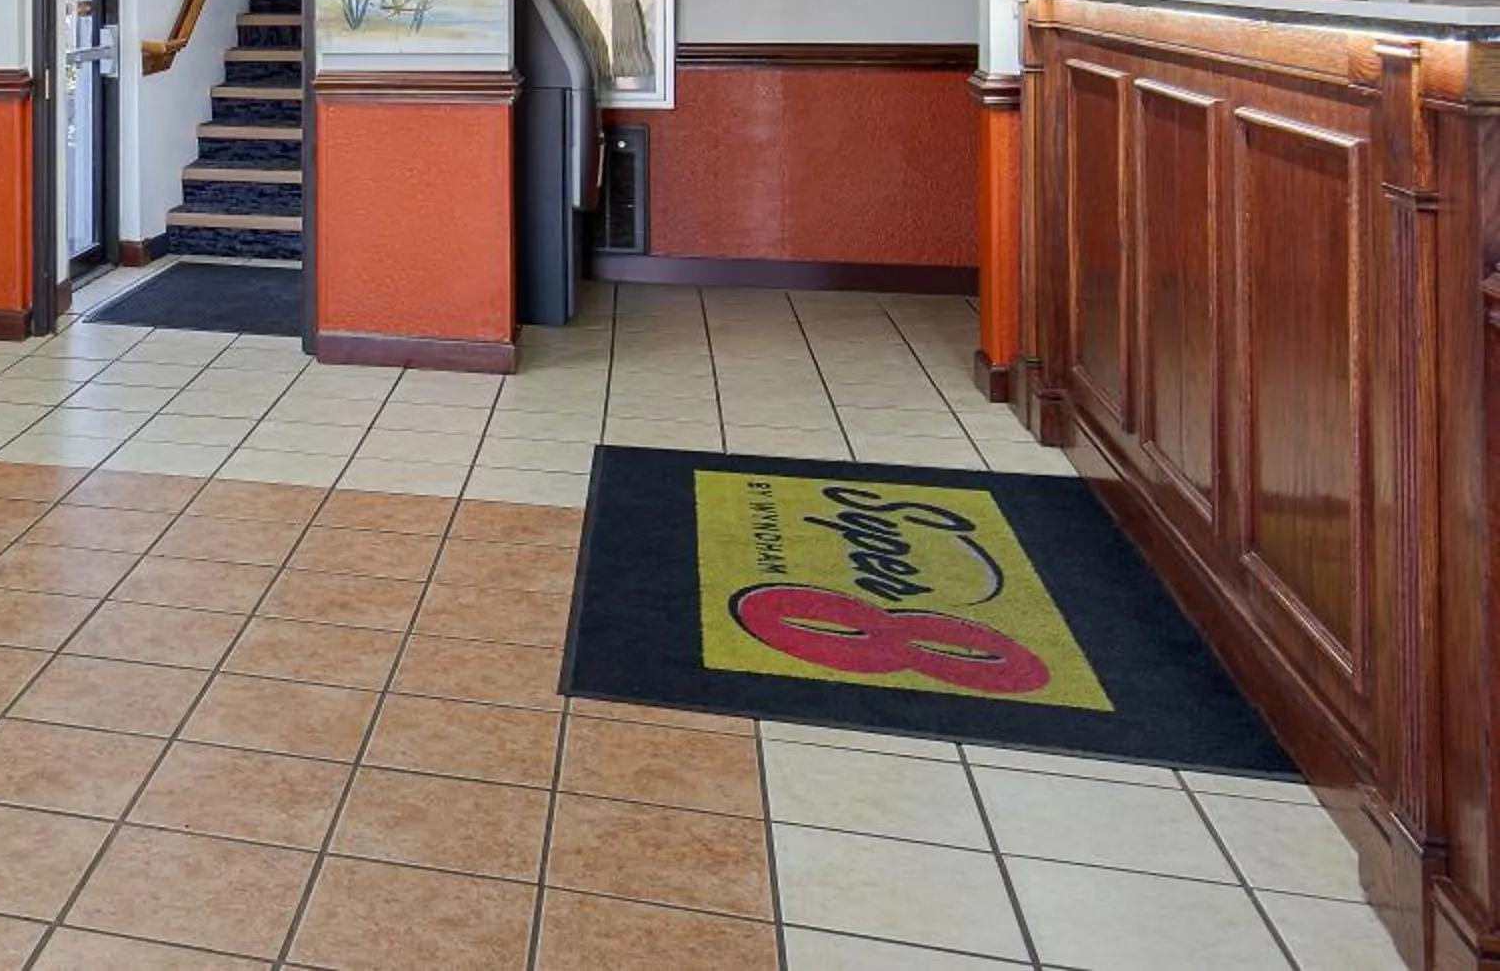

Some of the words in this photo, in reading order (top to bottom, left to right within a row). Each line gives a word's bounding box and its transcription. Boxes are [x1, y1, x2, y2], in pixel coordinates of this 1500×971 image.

[746, 481, 773, 498] BY
[748, 501, 788, 574] WYNDHAM
[803, 485, 976, 603] Super
[728, 582, 1050, 694] 8
